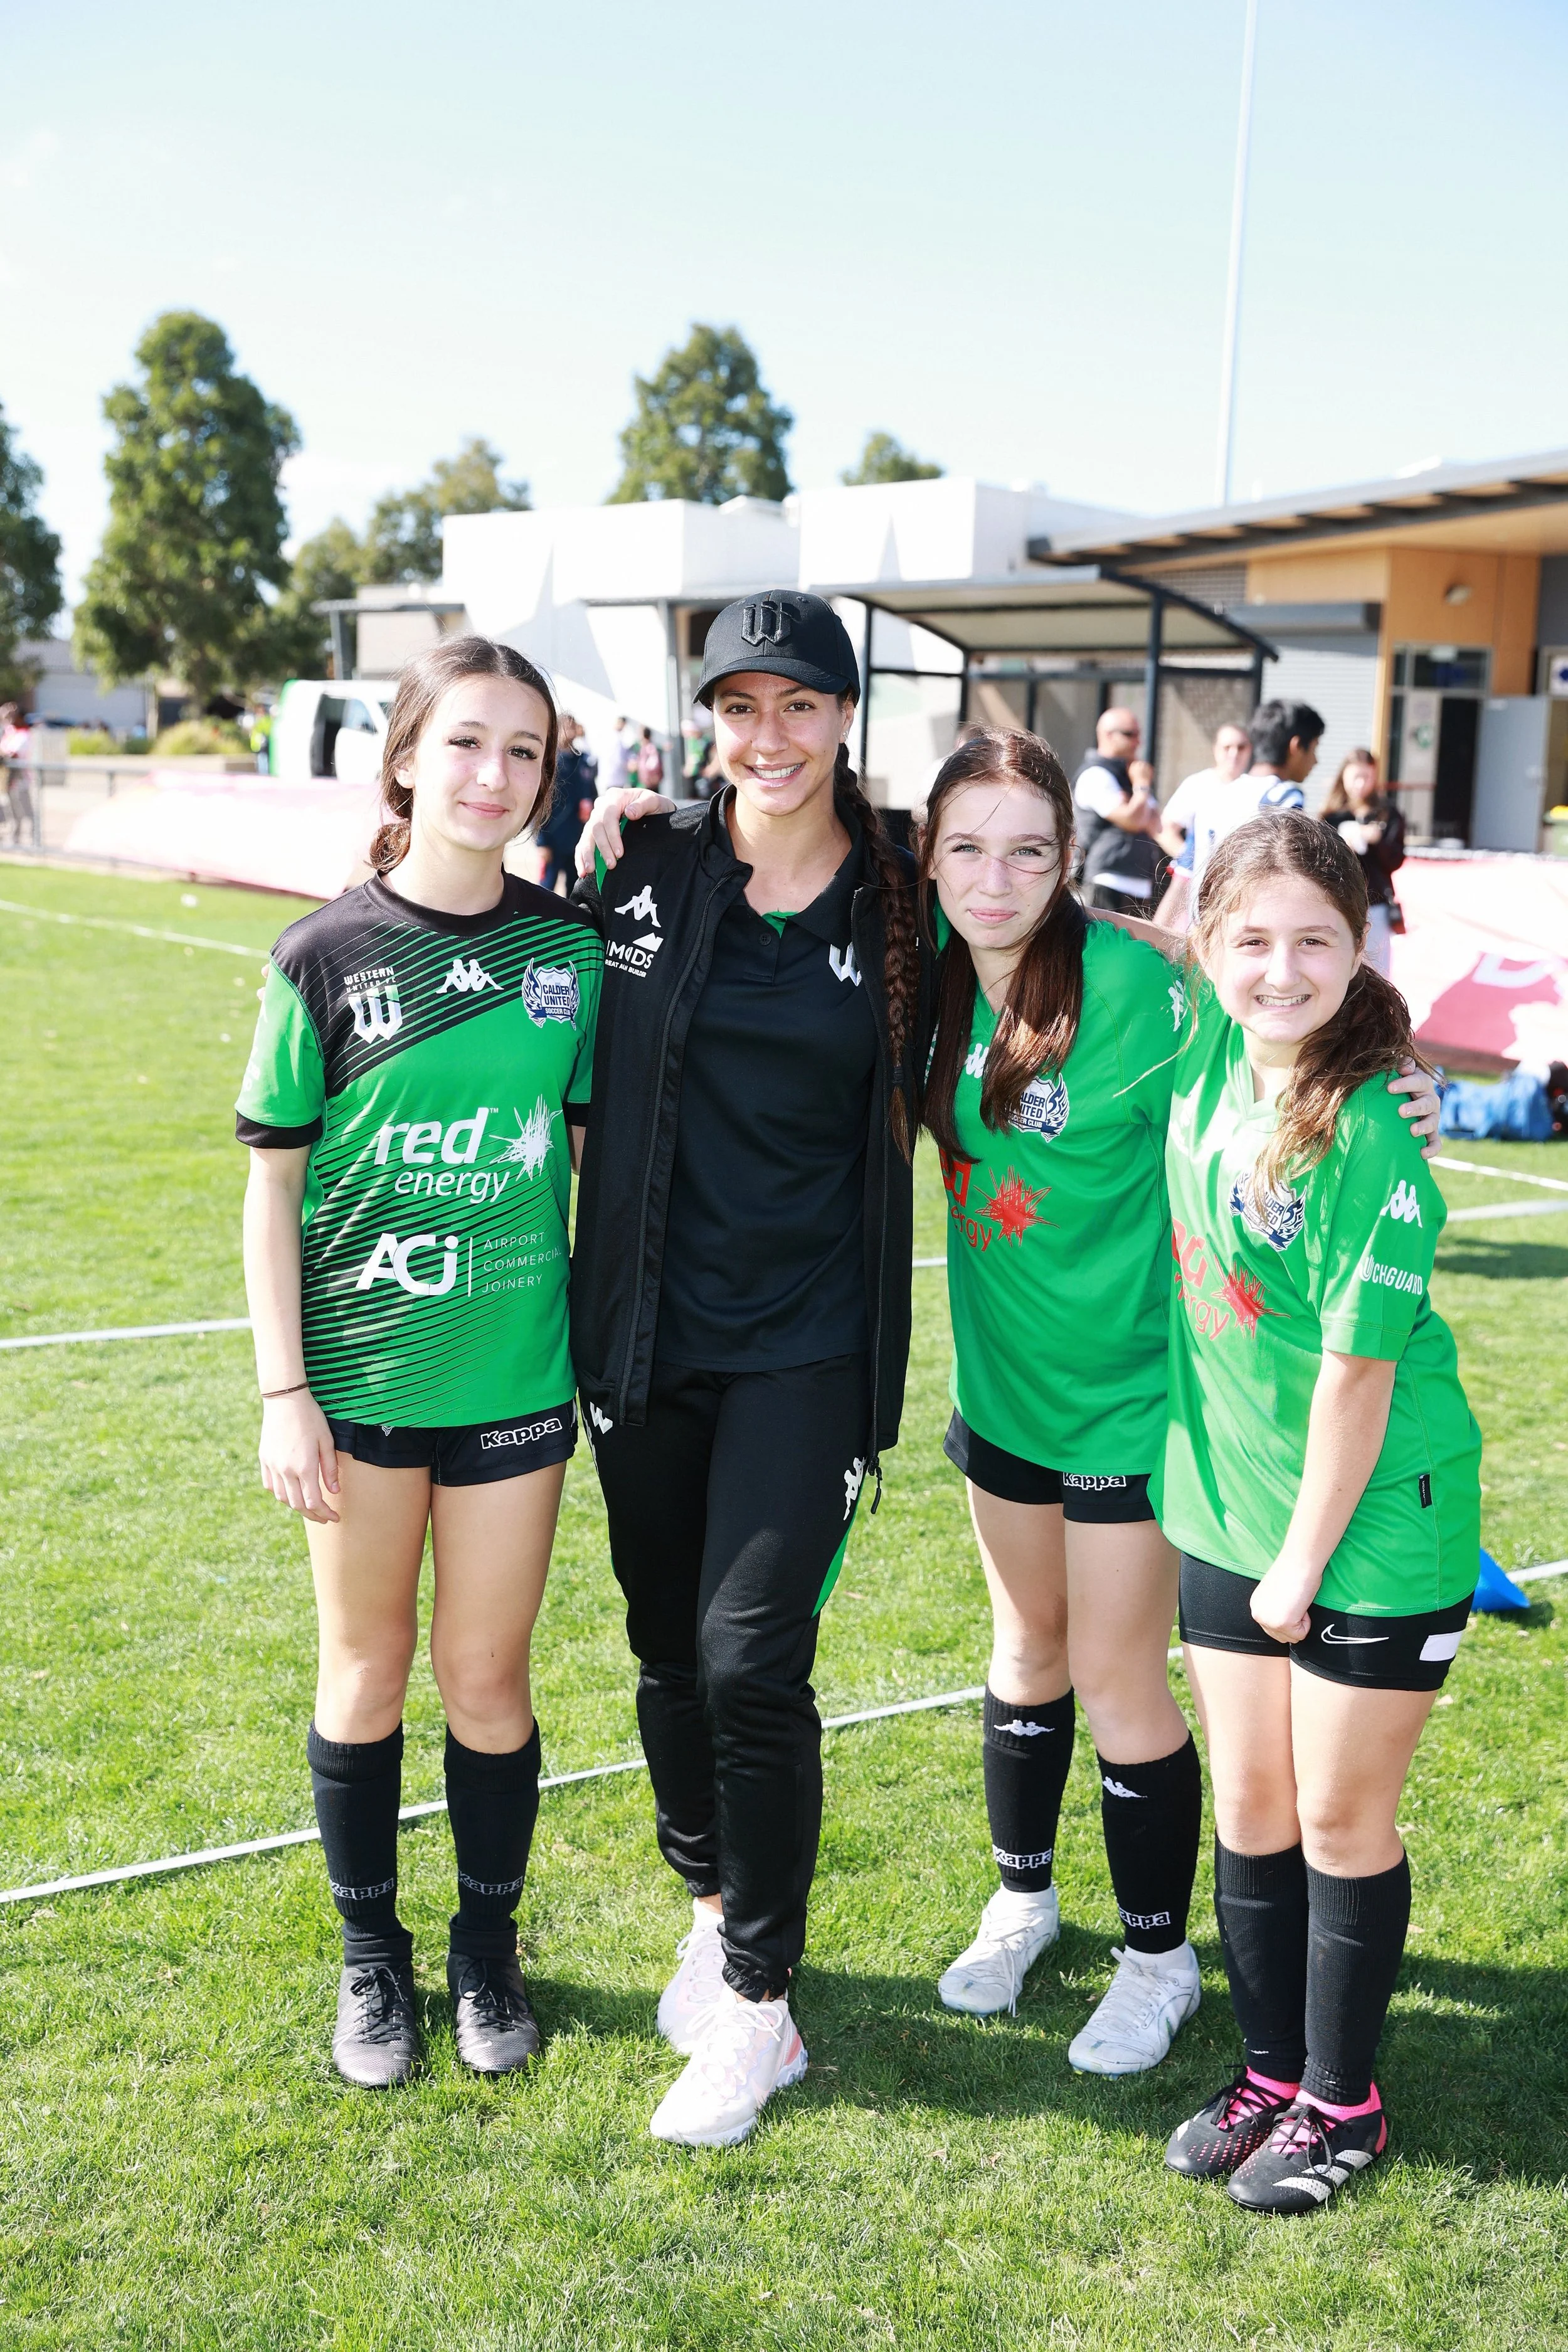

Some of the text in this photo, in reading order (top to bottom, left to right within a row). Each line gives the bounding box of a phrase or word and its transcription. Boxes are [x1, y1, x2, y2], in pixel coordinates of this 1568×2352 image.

[343, 967, 395, 986] WESTERN
[605, 959, 620, 968] REAT
[628, 966, 647, 978] BUILDER
[346, 980, 381, 993] UNITED
[543, 984, 570, 996] CALDER
[544, 995, 570, 1007] UNITED
[1019, 1091, 1046, 1108] ALDER
[1020, 1104, 1043, 1119] ITED
[1027, 1120, 1042, 1128] CLUB
[374, 1106, 489, 1165] red
[394, 1171, 511, 1204] energy
[951, 1205, 993, 1252] ergy
[483, 1232, 545, 1251] AIRPORT
[483, 1245, 562, 1272] COMMERCIAL
[482, 1273, 543, 1294] JOINERY
[1359, 1254, 1423, 1295] UCHGUARD
[480, 1417, 563, 1450] Kappa
[1062, 1471, 1127, 1491] Kappa
[992, 1844, 1053, 1870] Kappa
[329, 1877, 395, 1900] Kappa
[1118, 1904, 1172, 1929] appa
